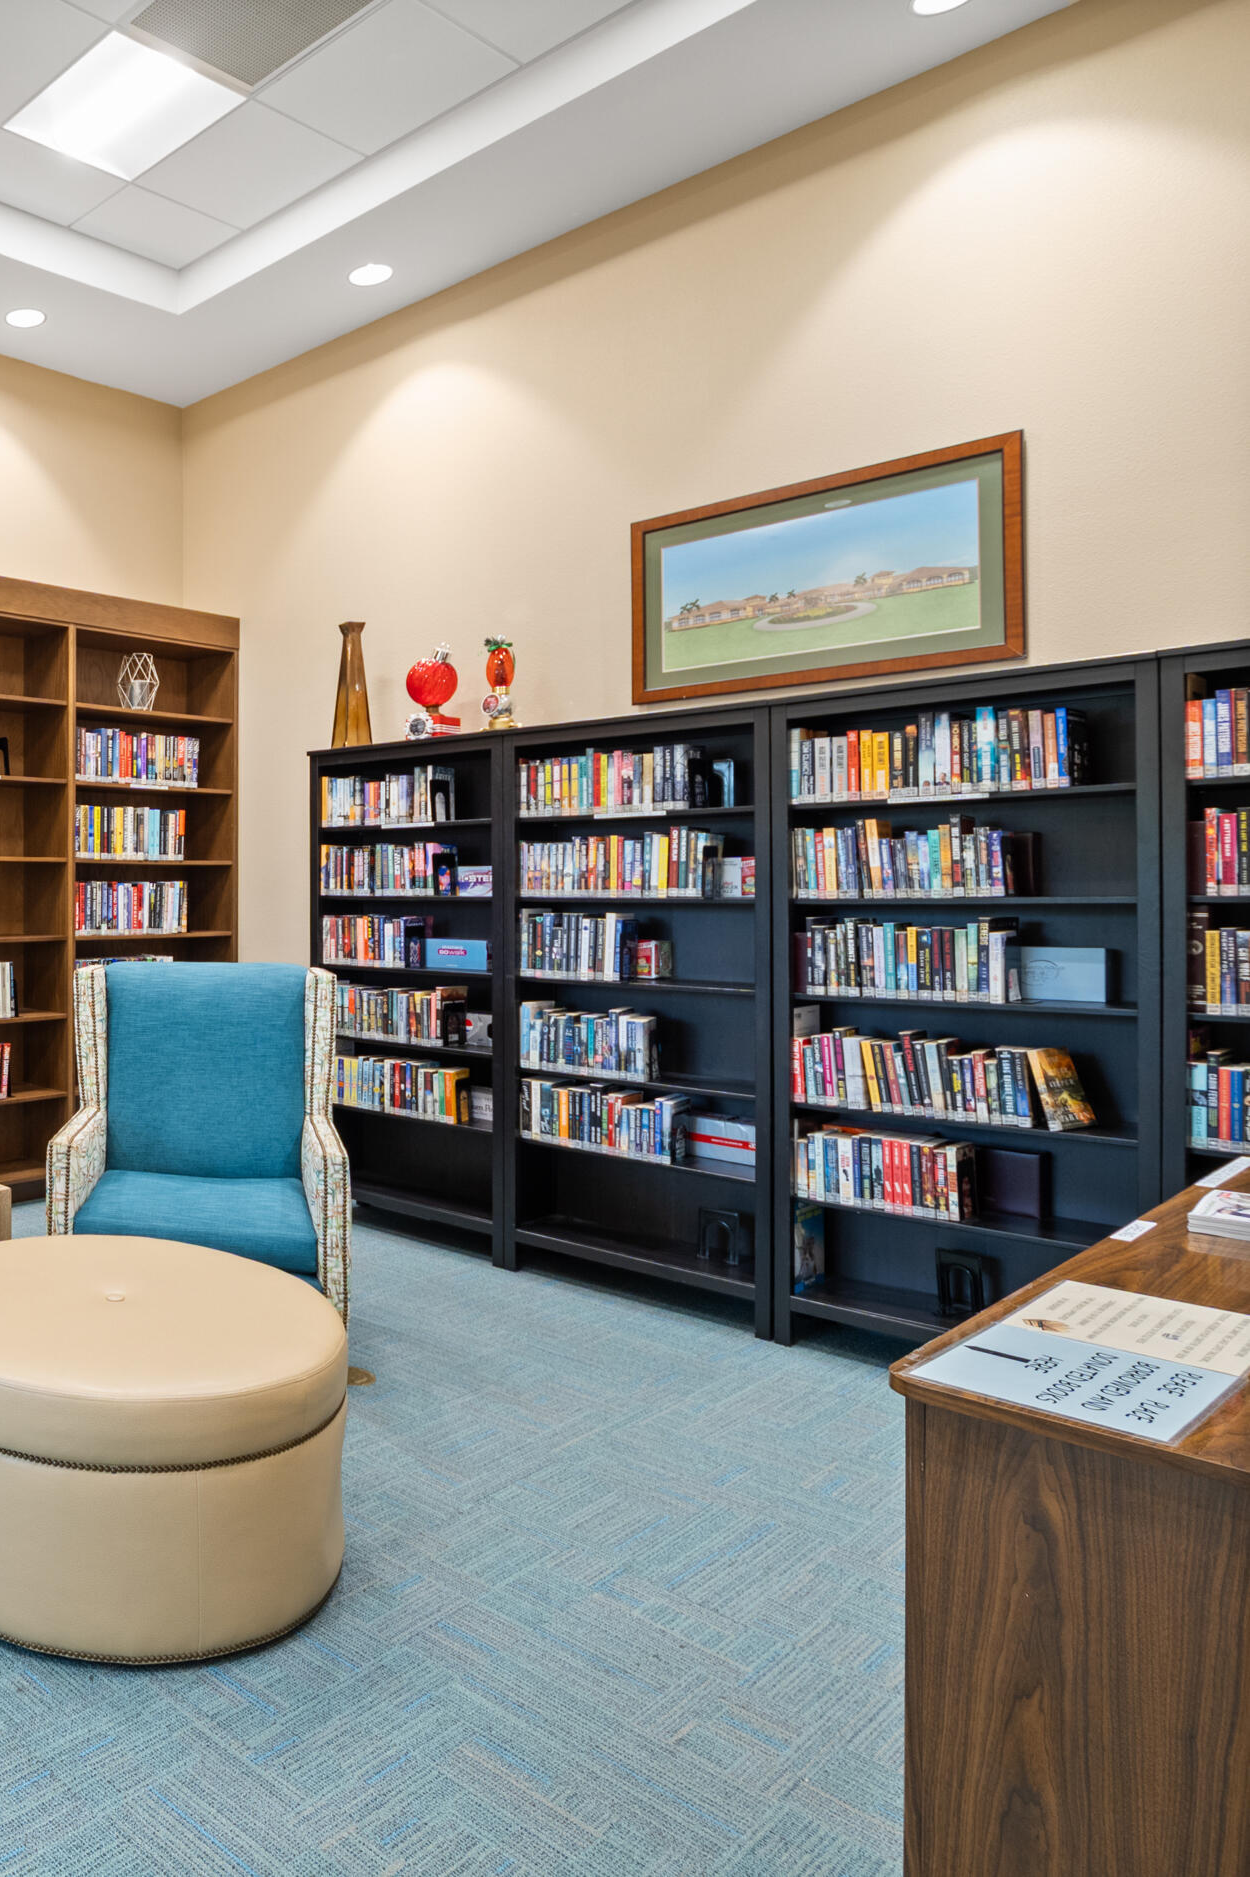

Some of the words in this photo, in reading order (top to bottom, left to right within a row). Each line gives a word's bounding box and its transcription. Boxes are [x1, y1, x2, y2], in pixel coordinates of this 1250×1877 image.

[1025, 1354, 1063, 1374] HERE
[1065, 1352, 1119, 1382] DONATED
[1100, 1361, 1160, 1397] BORROWED
[1157, 1371, 1203, 1397] PLEASE
[1036, 1380, 1081, 1404] BOOKS
[1081, 1394, 1116, 1411] AND
[1126, 1399, 1169, 1424] PLACE
